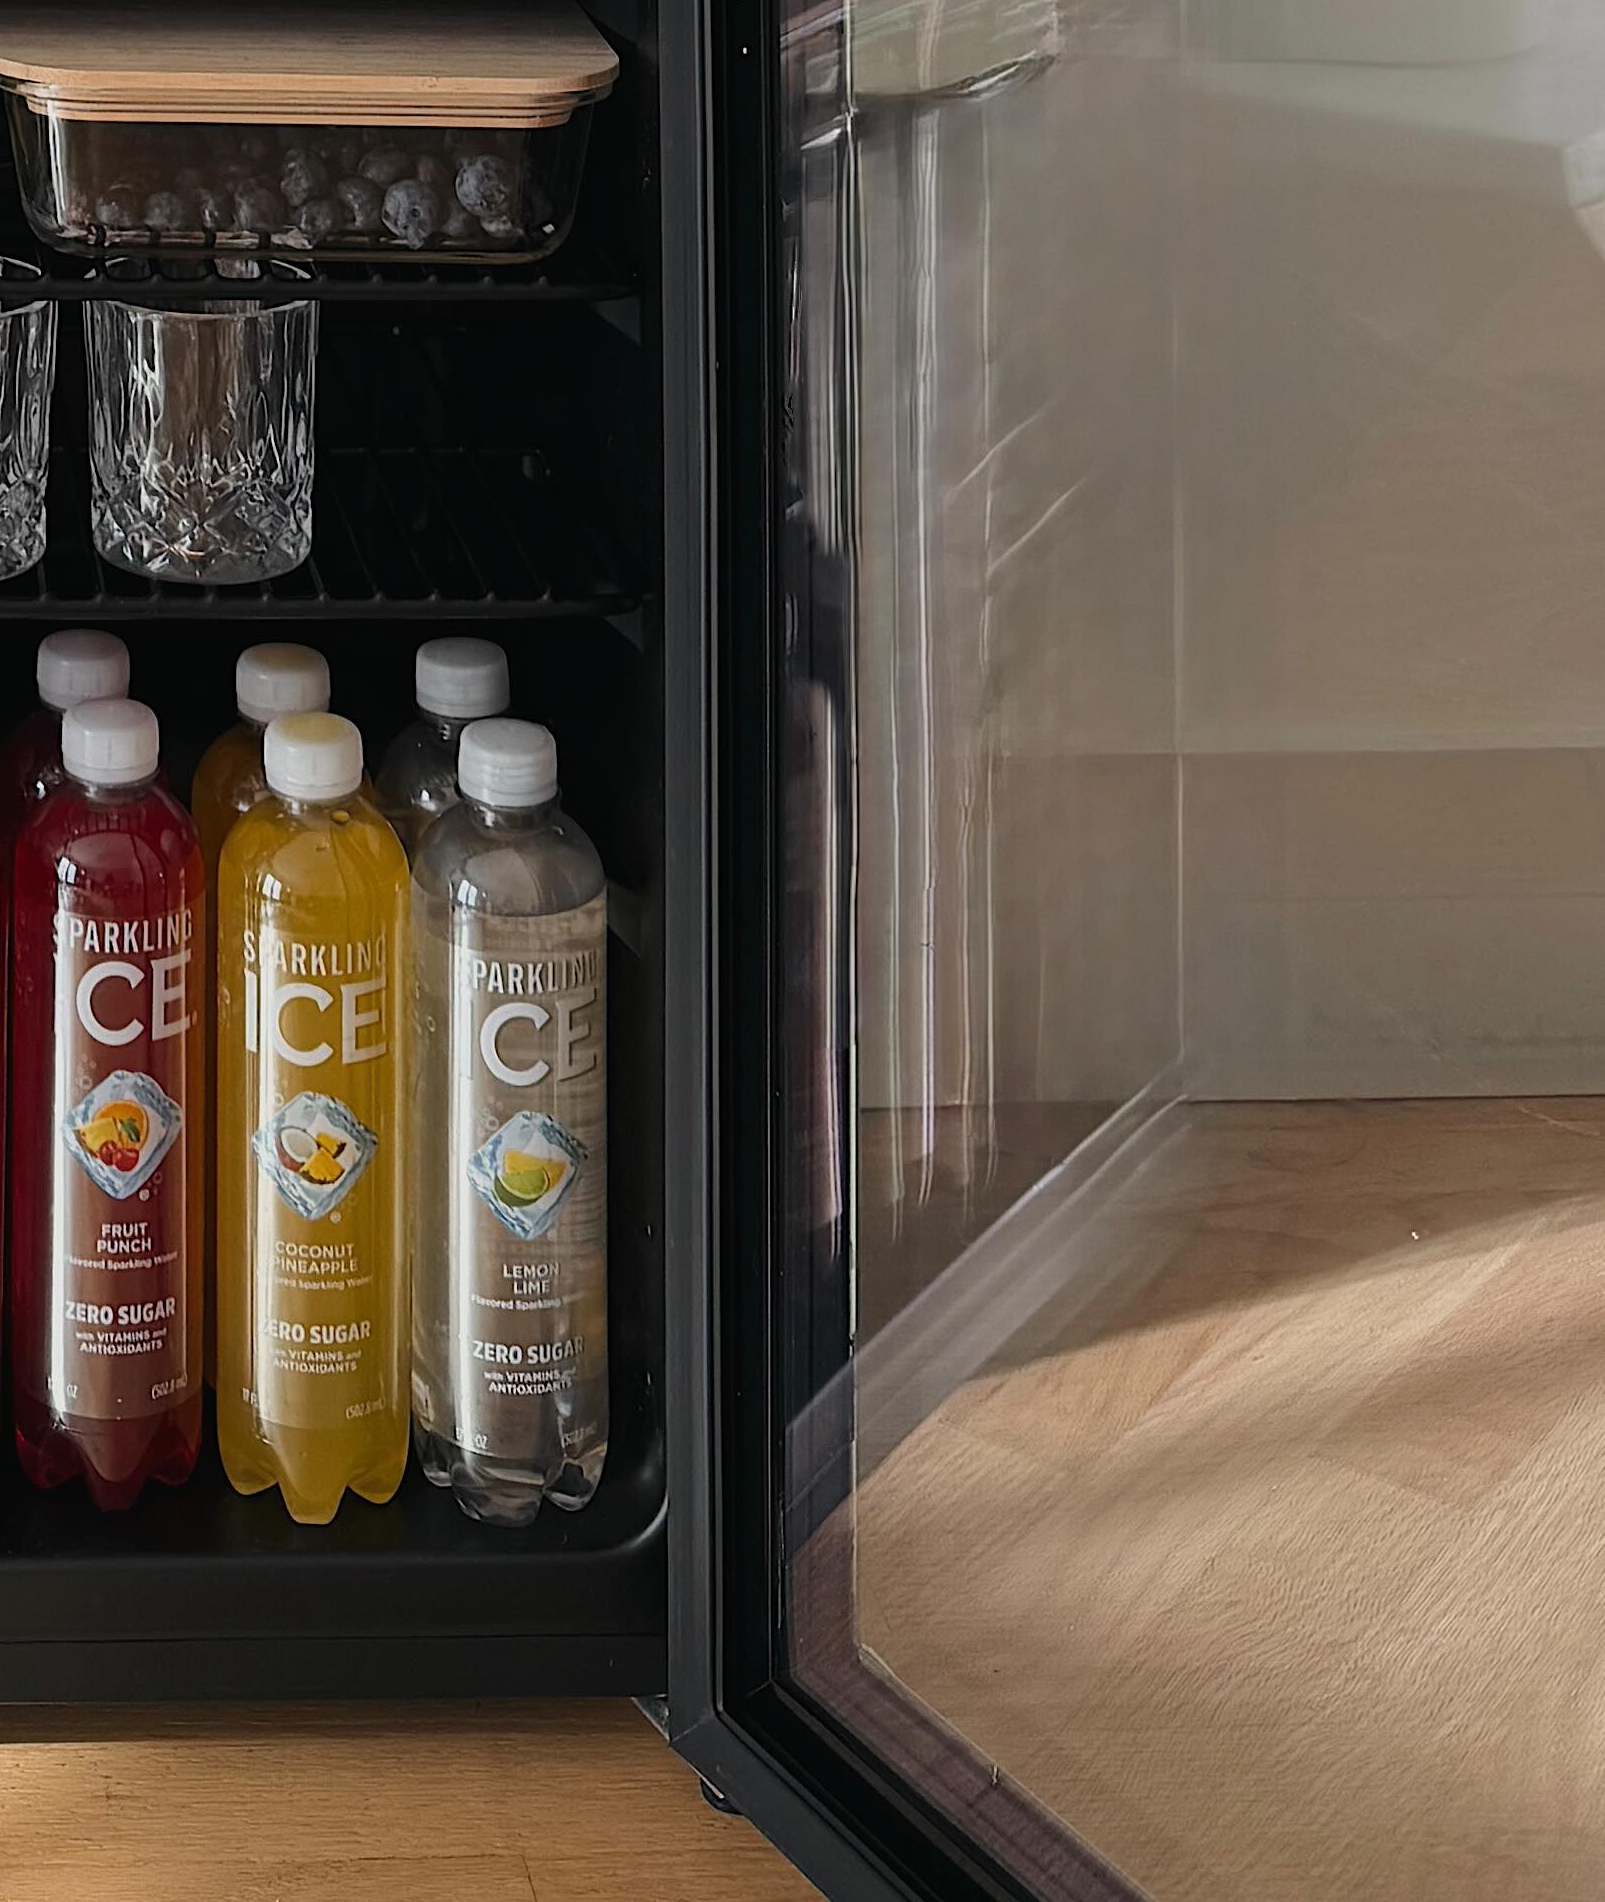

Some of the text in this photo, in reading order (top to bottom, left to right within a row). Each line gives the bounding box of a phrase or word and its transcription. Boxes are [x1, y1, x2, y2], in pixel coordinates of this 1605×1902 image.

[244, 929, 386, 976] SARKLING
[472, 951, 596, 995] PARKLIN
[75, 948, 191, 1046] CE
[244, 967, 386, 1067] ICE
[480, 988, 596, 1087] CE
[102, 1223, 147, 1238] FRUIT
[97, 1238, 152, 1253] PUNCH
[276, 1241, 354, 1258] COCONUT
[274, 1257, 358, 1274] PINEAPPLE
[503, 1263, 559, 1278] LEMON
[513, 1280, 550, 1294] LIME
[66, 1297, 175, 1325] ZERO SUGAR
[97, 1330, 150, 1343] VITAMINS
[310, 1320, 370, 1344] SUGAR
[80, 1339, 162, 1355] ANTIOXIDANTS
[289, 1349, 343, 1361] VITAMINS
[473, 1337, 584, 1364] ZERO SUGAR
[274, 1361, 357, 1374] ANTIOXIDANTS
[506, 1370, 560, 1383] VITAMINS
[489, 1379, 572, 1394] ANTIOXIDANTS
